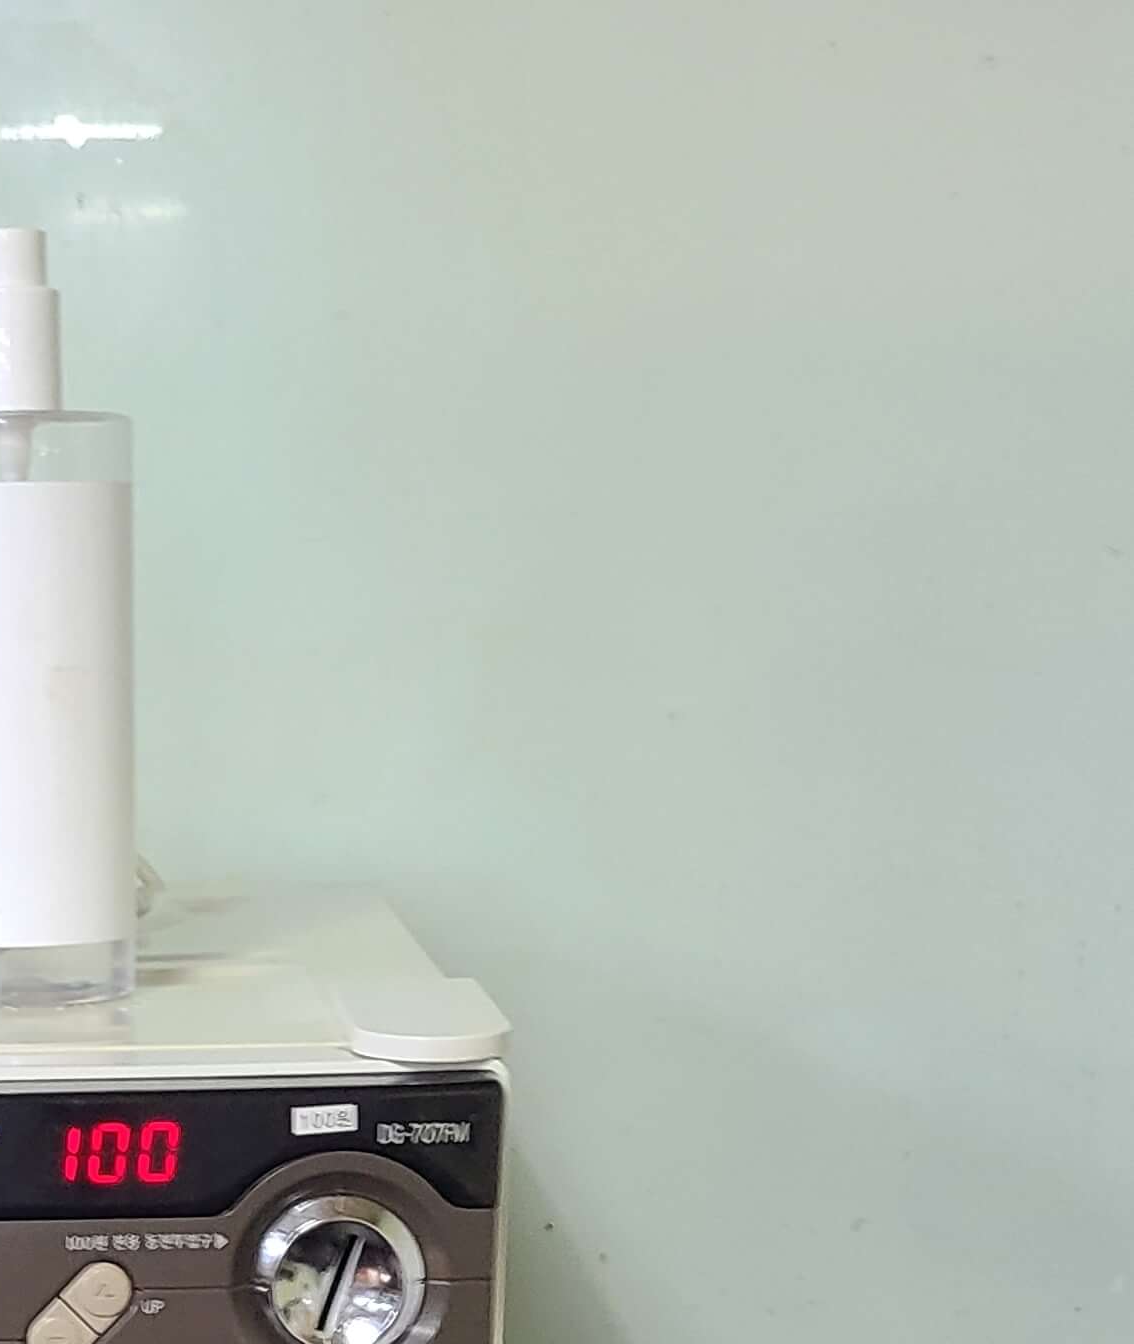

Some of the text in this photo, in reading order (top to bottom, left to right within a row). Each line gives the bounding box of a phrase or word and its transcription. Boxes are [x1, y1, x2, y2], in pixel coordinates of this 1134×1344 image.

[298, 1110, 352, 1129] 100원
[65, 1121, 181, 1184] 100
[140, 1299, 165, 1314] UP
